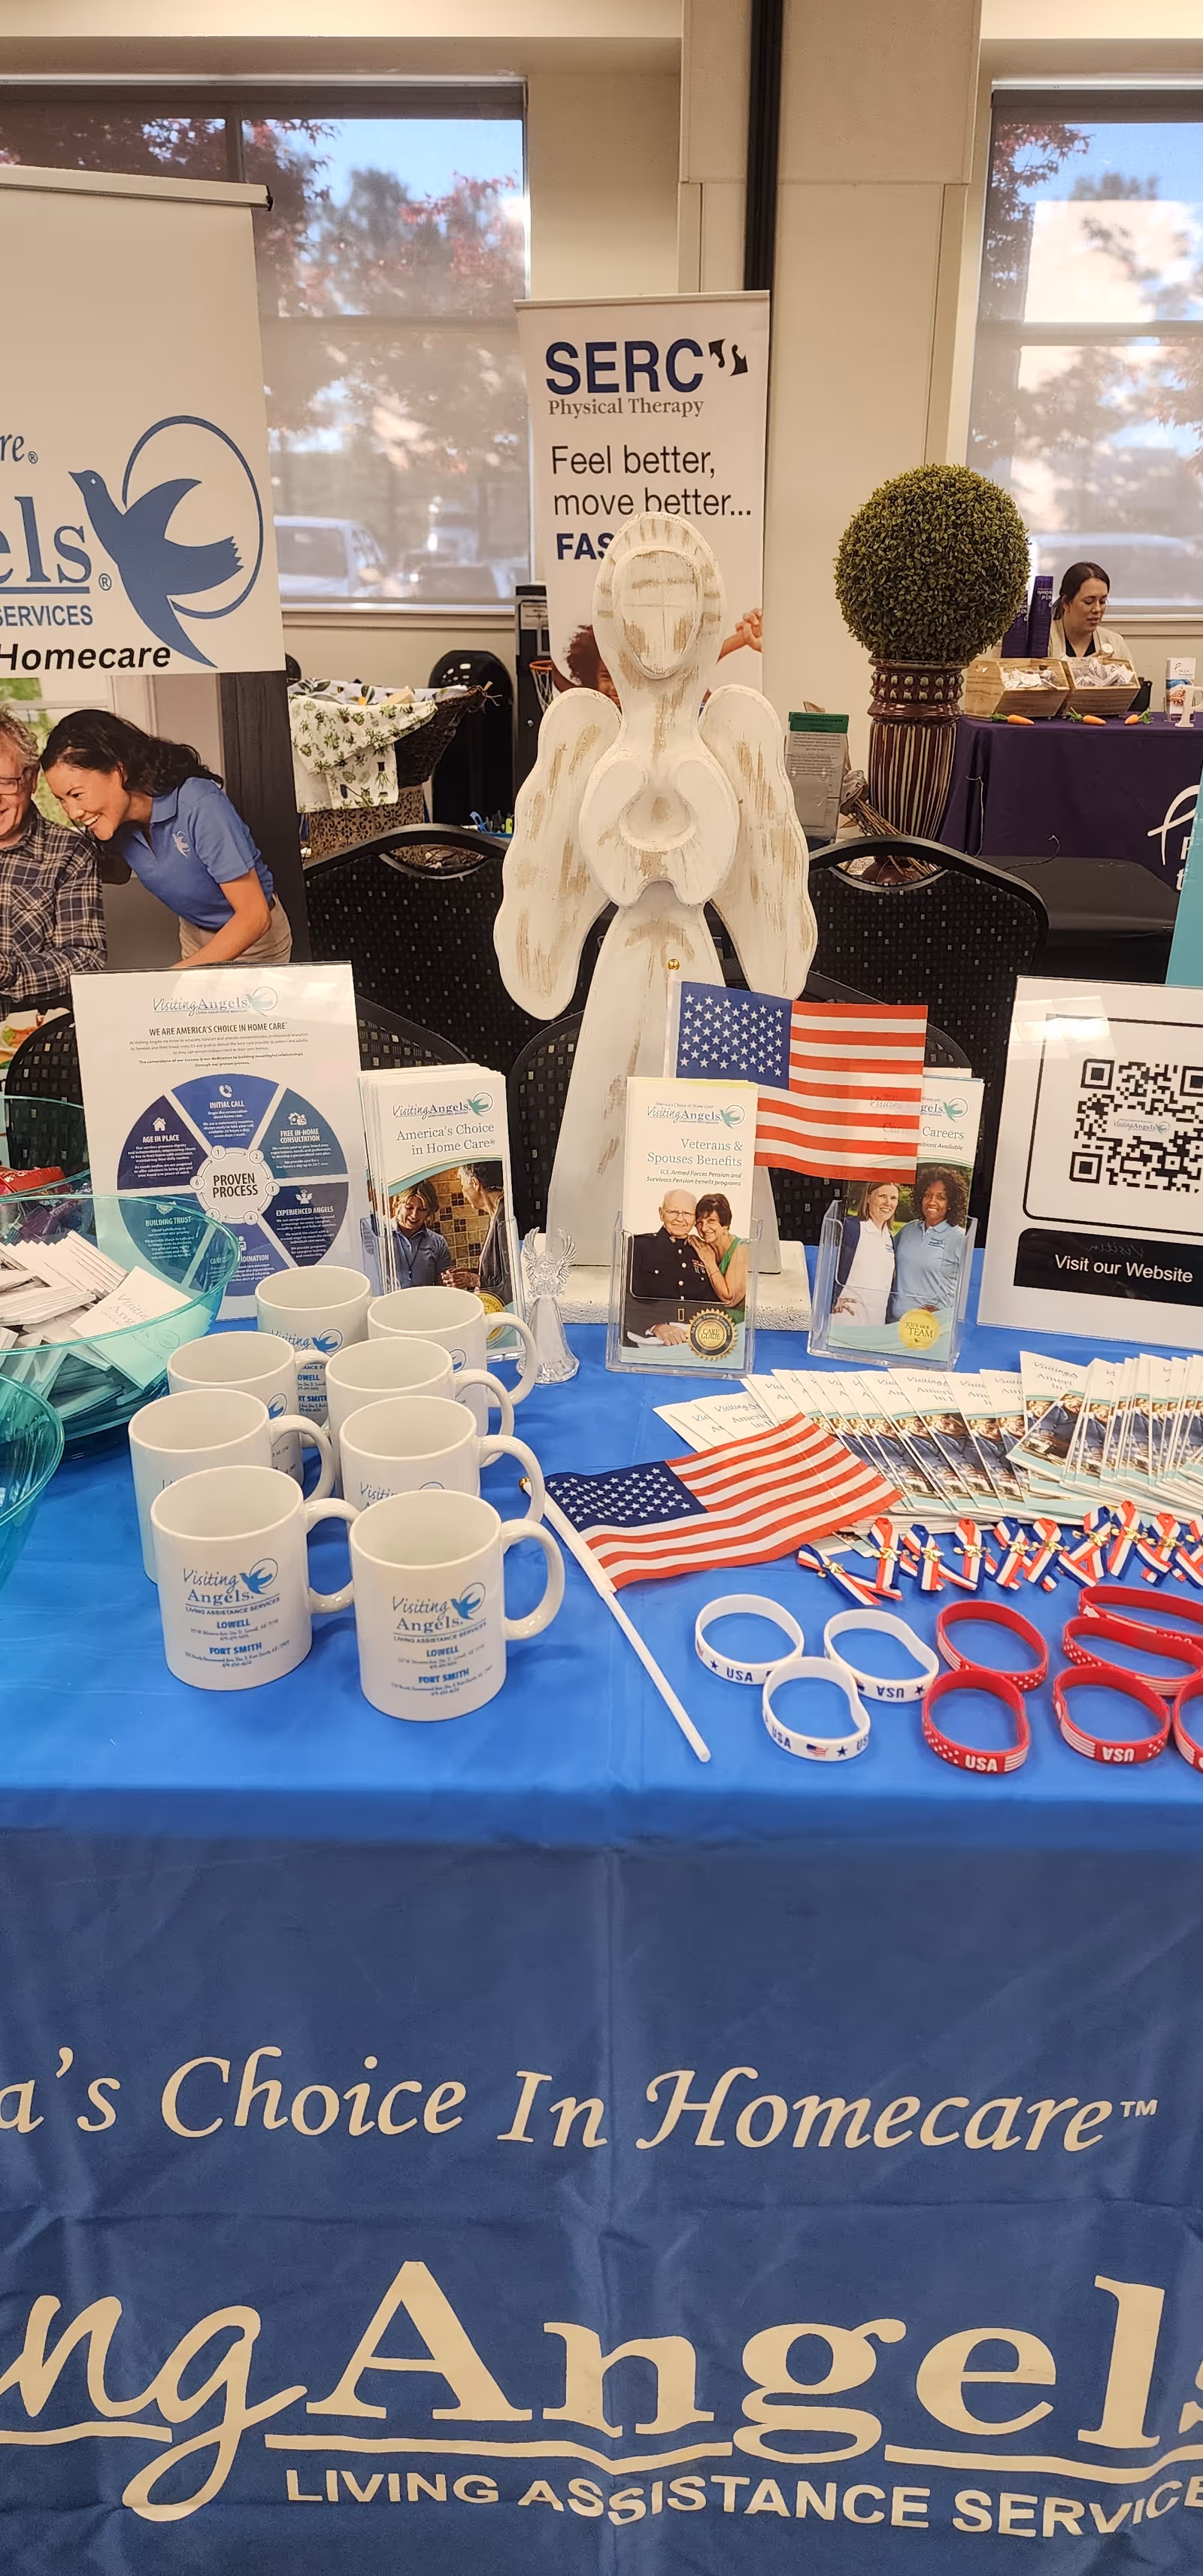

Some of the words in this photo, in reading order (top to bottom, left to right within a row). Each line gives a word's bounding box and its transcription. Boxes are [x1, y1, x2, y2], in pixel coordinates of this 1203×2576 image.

[545, 338, 704, 395] SERC
[548, 398, 623, 419] Physical
[629, 398, 705, 418] Therapy
[552, 445, 611, 474] Feel
[623, 445, 715, 478] better,
[554, 494, 634, 515] move
[0, 644, 171, 671] Homecare
[153, 998, 198, 1017] Visiting
[162, 1027, 174, 1035] ARE
[176, 1025, 212, 1035] AMERICA'S
[214, 1024, 238, 1033] CHOICE
[239, 1023, 246, 1032] IN
[247, 1023, 268, 1031] HOME
[209, 1101, 230, 1109] INITIAL
[392, 1104, 429, 1120] Visiting
[647, 1106, 681, 1123] Visiting
[162, 1134, 180, 1142] PLACE
[294, 1128, 320, 1136] IN-HOME
[396, 1125, 453, 1141] America's
[456, 1122, 495, 1135] Choice
[922, 1126, 965, 1139] Careers
[280, 1135, 320, 1144] CONSULTATION
[680, 1138, 730, 1151] Veterans
[734, 1141, 742, 1151] &
[411, 1143, 423, 1156] in
[426, 1142, 461, 1153] Home
[937, 1143, 963, 1151] Available
[647, 1152, 693, 1165] Spouses
[696, 1154, 742, 1166] Benefits
[213, 1173, 255, 1186] PROVEN
[212, 1184, 259, 1198] PROCESS
[276, 1208, 312, 1217] EXPERIENCED
[313, 1205, 335, 1214] ANGELS
[145, 1217, 172, 1227] BUILDING
[173, 1215, 192, 1224] TRUST
[1055, 1253, 1089, 1272] Visit
[1093, 1261, 1122, 1274] our
[1126, 1262, 1193, 1283] Website
[908, 1327, 933, 1338] TEAM
[183, 1568, 239, 1593] Visiting
[206, 1607, 248, 1615] ASSISTANCE
[250, 1597, 280, 1612] SERVICES
[392, 1596, 450, 1621] Visiting
[217, 1618, 250, 1629] LOWELL
[417, 1634, 458, 1643] ASSISTANCE
[209, 1647, 231, 1656] FORT
[233, 1642, 262, 1654] SMITH
[426, 1645, 459, 1657] LOWELL
[418, 1675, 440, 1684] FORT
[442, 1668, 470, 1682] SMITH
[726, 1668, 753, 1683] USA
[876, 1685, 905, 1699] USA
[771, 1725, 792, 1749] USA
[1101, 1746, 1135, 1762] USA
[965, 1754, 998, 1772] USA
[161, 2045, 467, 2138] Choice
[497, 2071, 606, 2149] In
[286, 2469, 499, 2504] LIVING
[518, 2474, 931, 2530] ASSISTANCE
